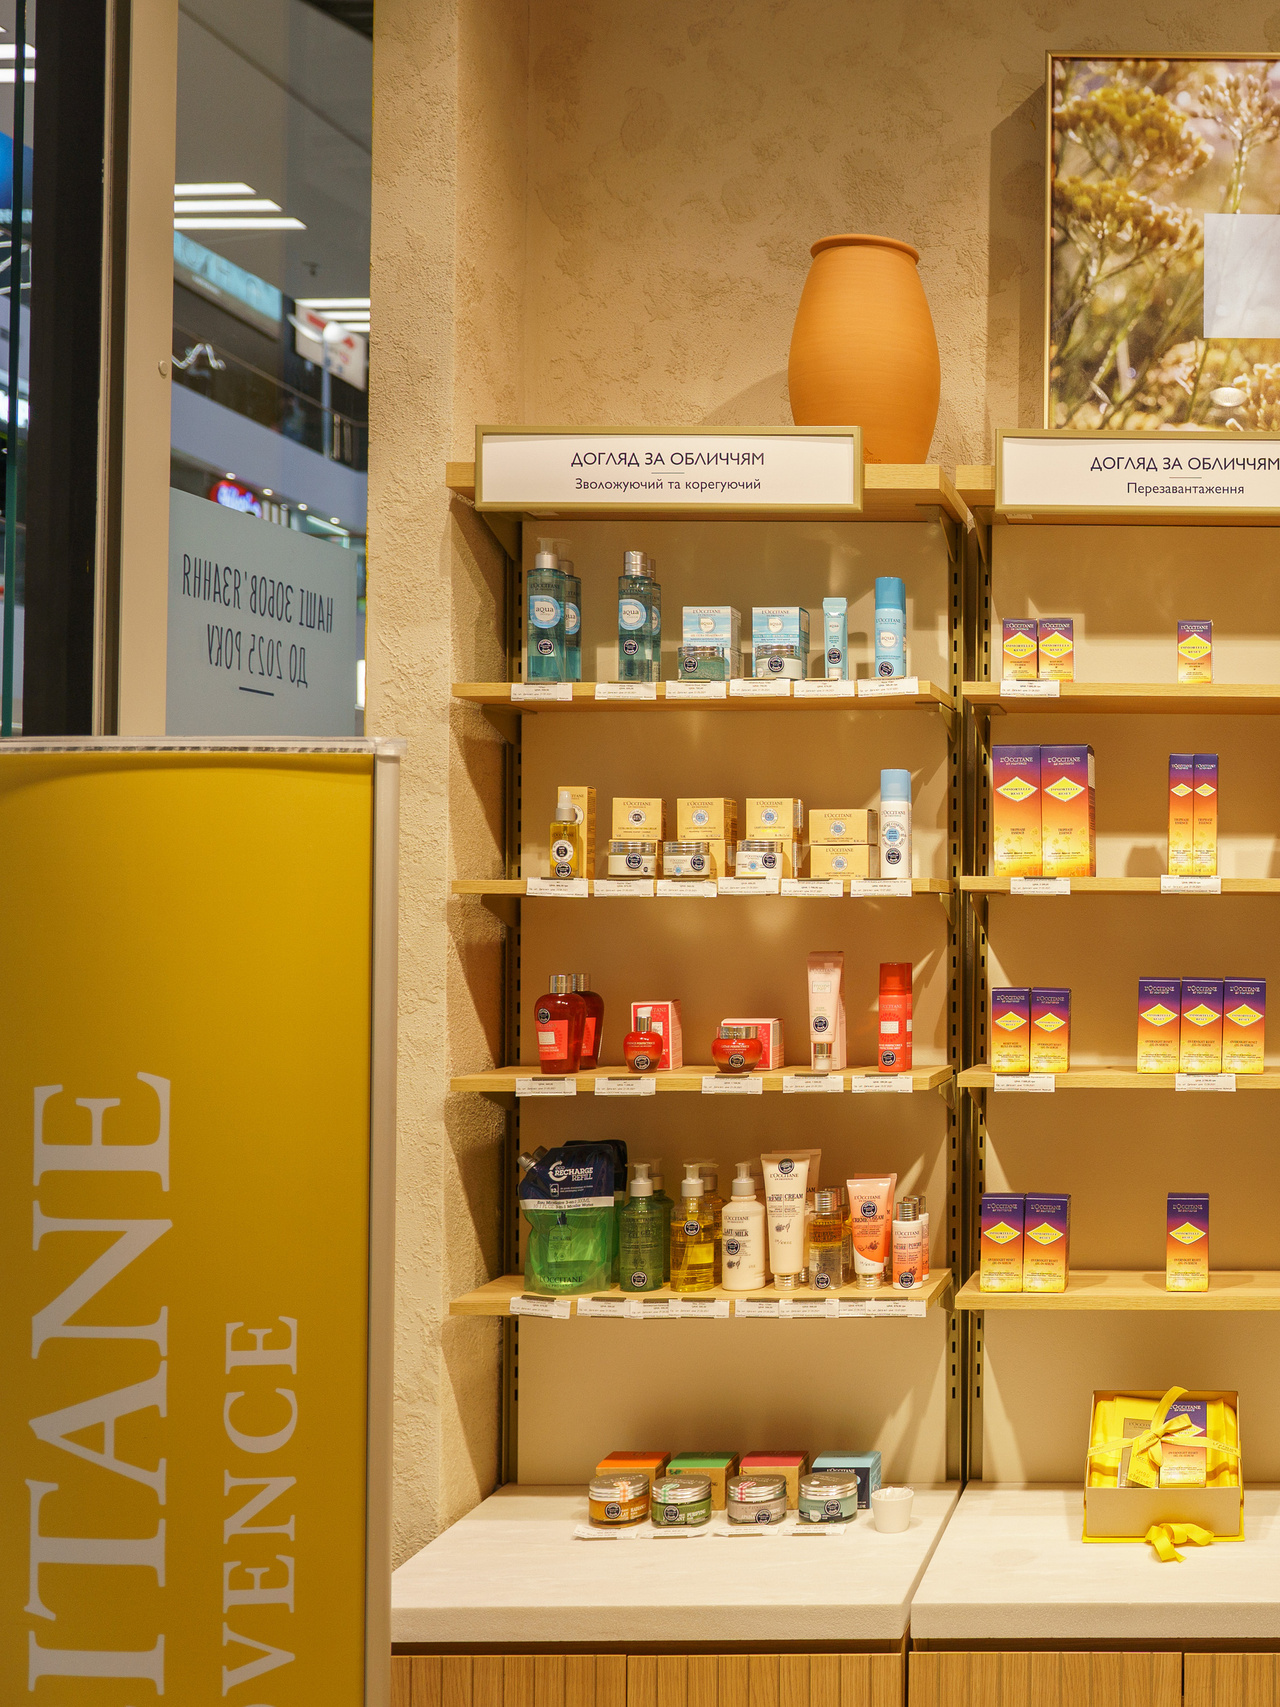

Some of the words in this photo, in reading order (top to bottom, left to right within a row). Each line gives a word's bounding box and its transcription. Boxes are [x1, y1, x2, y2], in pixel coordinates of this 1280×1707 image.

[571, 452, 640, 467] ДОГЛЯД
[644, 452, 665, 466] ЗА
[670, 452, 765, 466] ОБЛИЧЧЯМ
[1090, 457, 1158, 472] ДОГЛЯД
[1162, 457, 1183, 470] ЗА
[1188, 457, 1280, 471] ОБЛИЧЧЯМ
[575, 477, 663, 493] Зволожуючий
[668, 481, 681, 490] та
[685, 478, 761, 493] корегуючий
[1127, 482, 1245, 497] Перезавантаження
[554, 1167, 594, 1177] RECHARGE
[571, 1173, 593, 1182] REFILL
[24, 1071, 173, 1706] ITANE
[222, 1315, 298, 1706] VENCE
